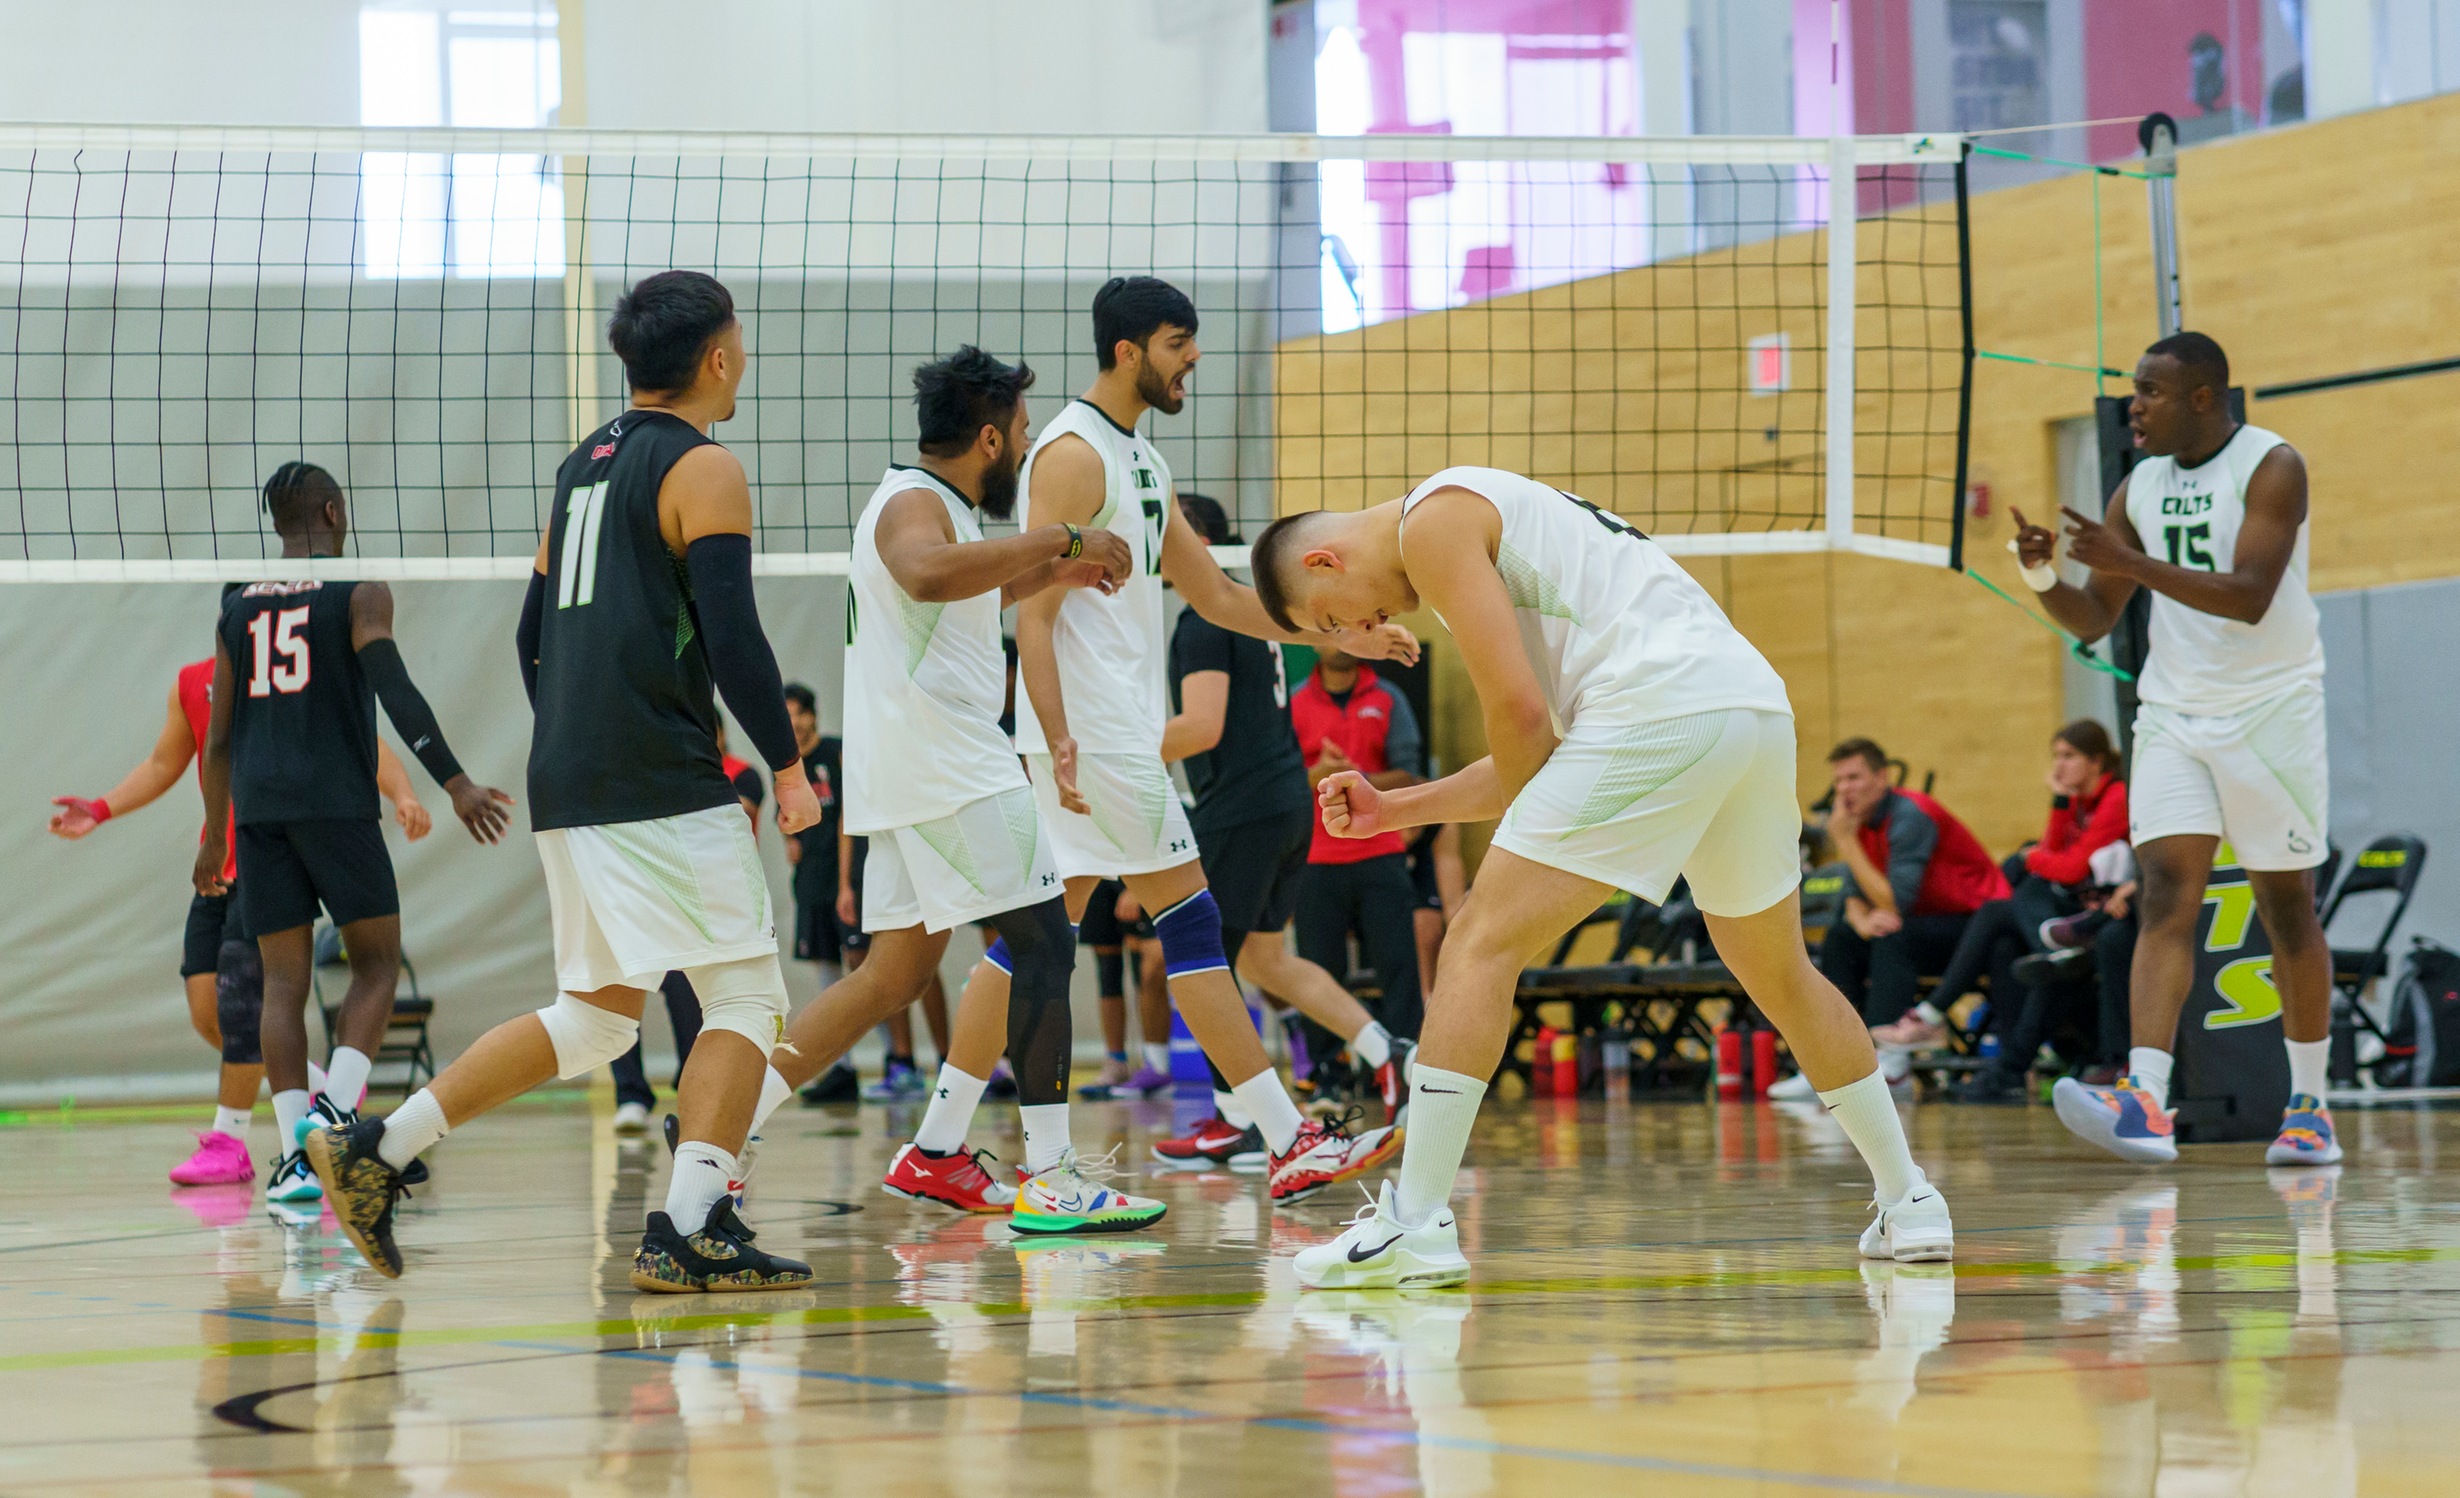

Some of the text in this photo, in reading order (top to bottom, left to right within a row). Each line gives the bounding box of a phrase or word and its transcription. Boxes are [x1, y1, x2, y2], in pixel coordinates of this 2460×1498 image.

[558, 479, 610, 610] 11
[2163, 521, 2216, 573] 15
[247, 604, 311, 698] 15
